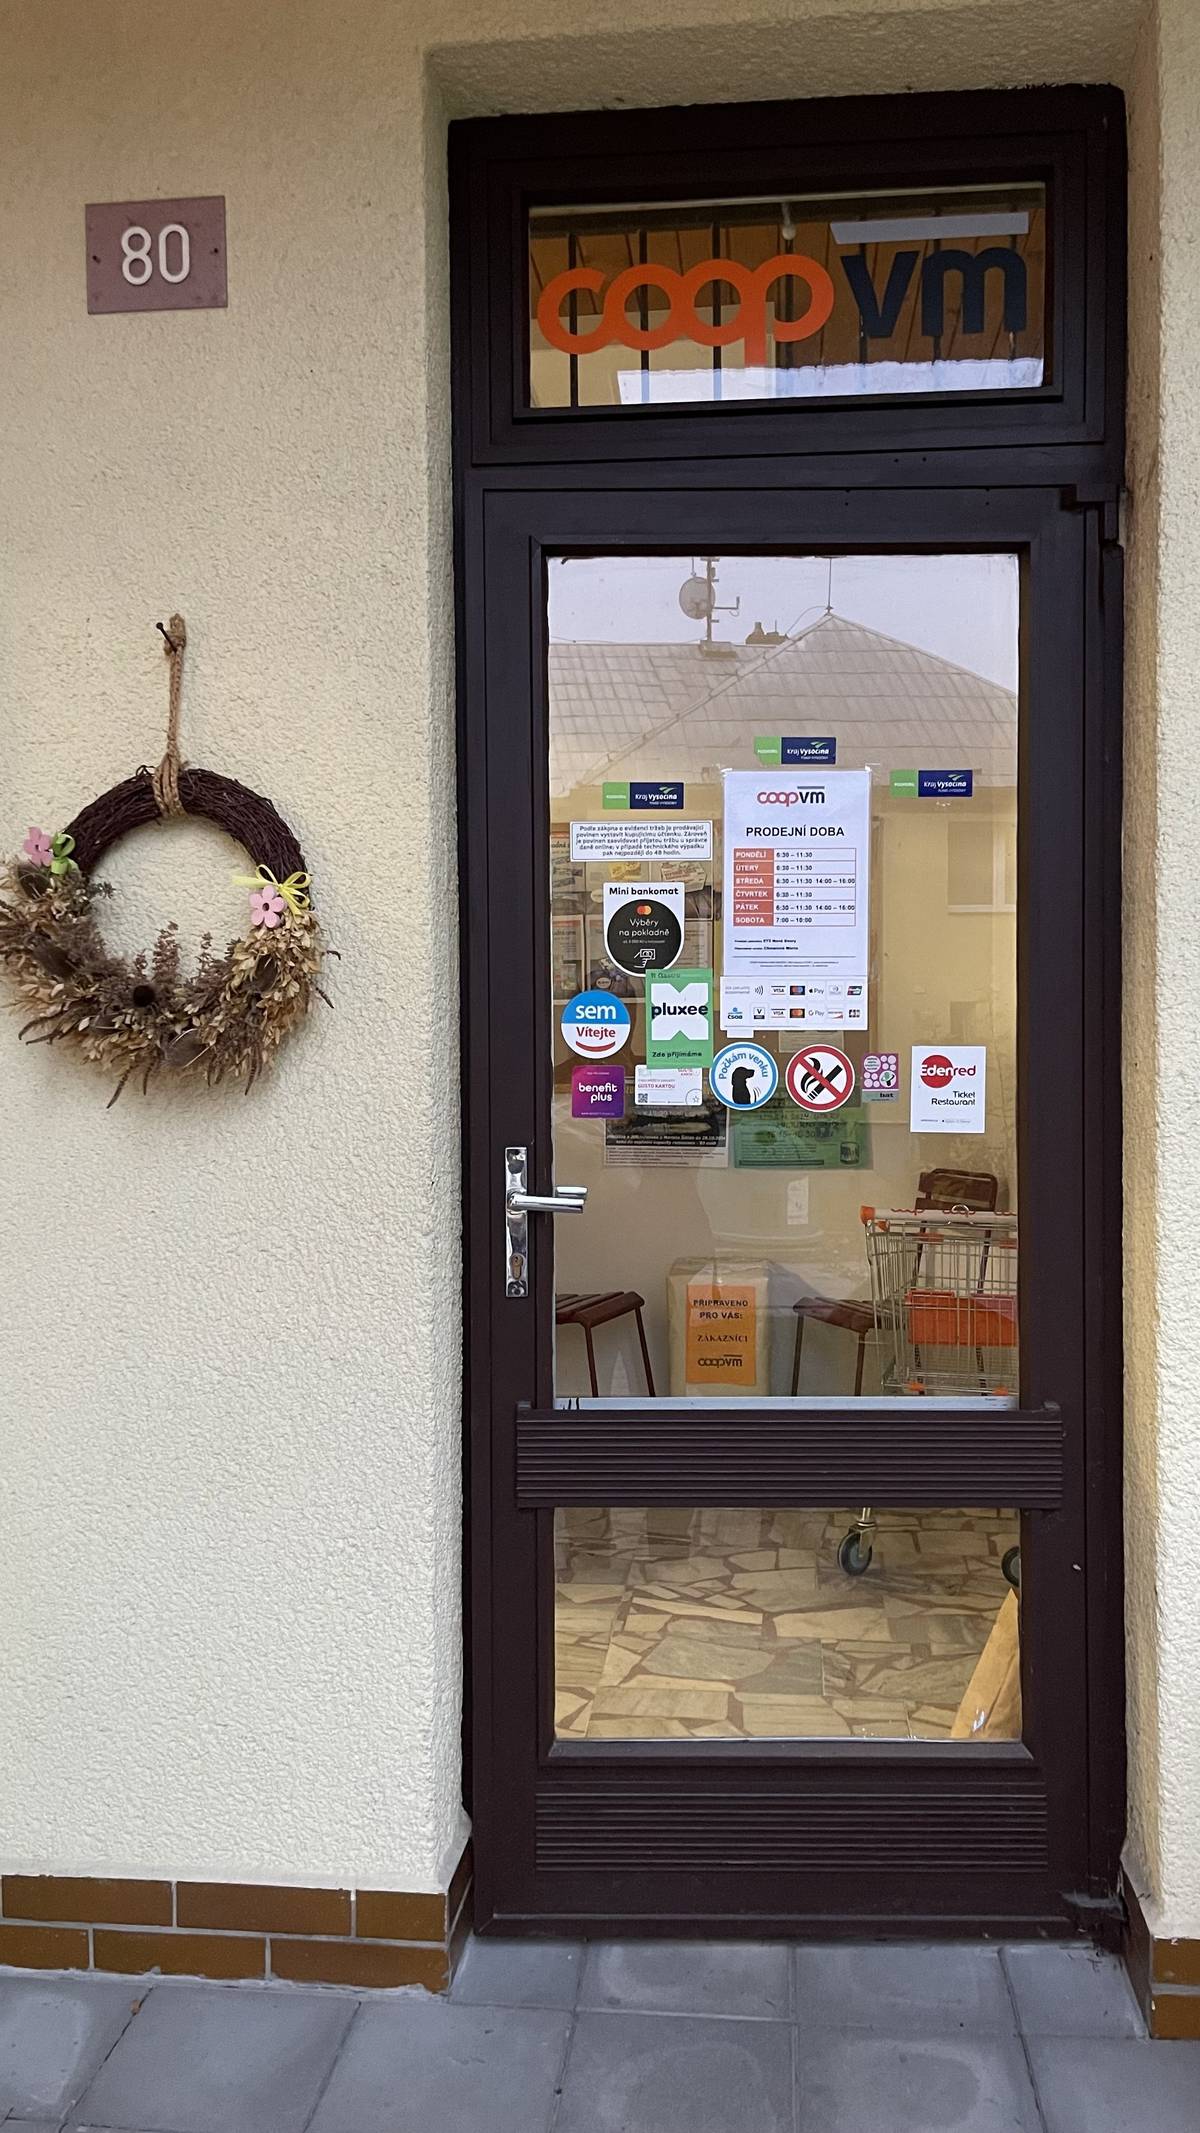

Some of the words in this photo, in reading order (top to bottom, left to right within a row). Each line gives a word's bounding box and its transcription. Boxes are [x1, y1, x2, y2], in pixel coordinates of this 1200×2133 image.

[121, 224, 190, 285] 80
[537, 254, 835, 366] coop
[746, 824, 807, 837] PRODEJNÍ
[810, 826, 845, 837] DOBA
[735, 851, 767, 859] PONDĚLÍ
[735, 877, 764, 885] STŘEDA
[609, 887, 629, 895] Mini
[631, 887, 679, 895] bankomat
[735, 903, 759, 911] PÁTEK
[630, 919, 659, 928] Výběry
[632, 928, 670, 937] pokladně
[575, 1004, 617, 1020] sem
[651, 1002, 709, 1020] pluxee
[576, 1026, 617, 1040] Vítejte
[667, 1050, 702, 1059] přijímáme
[719, 1053, 747, 1079] Počkám
[749, 1053, 769, 1078] venku
[921, 1065, 976, 1077] Edenred
[578, 1082, 618, 1093] benefit
[591, 1092, 613, 1104] plus
[931, 1098, 976, 1106] Restaurant
[700, 1311, 718, 1319] PRO
